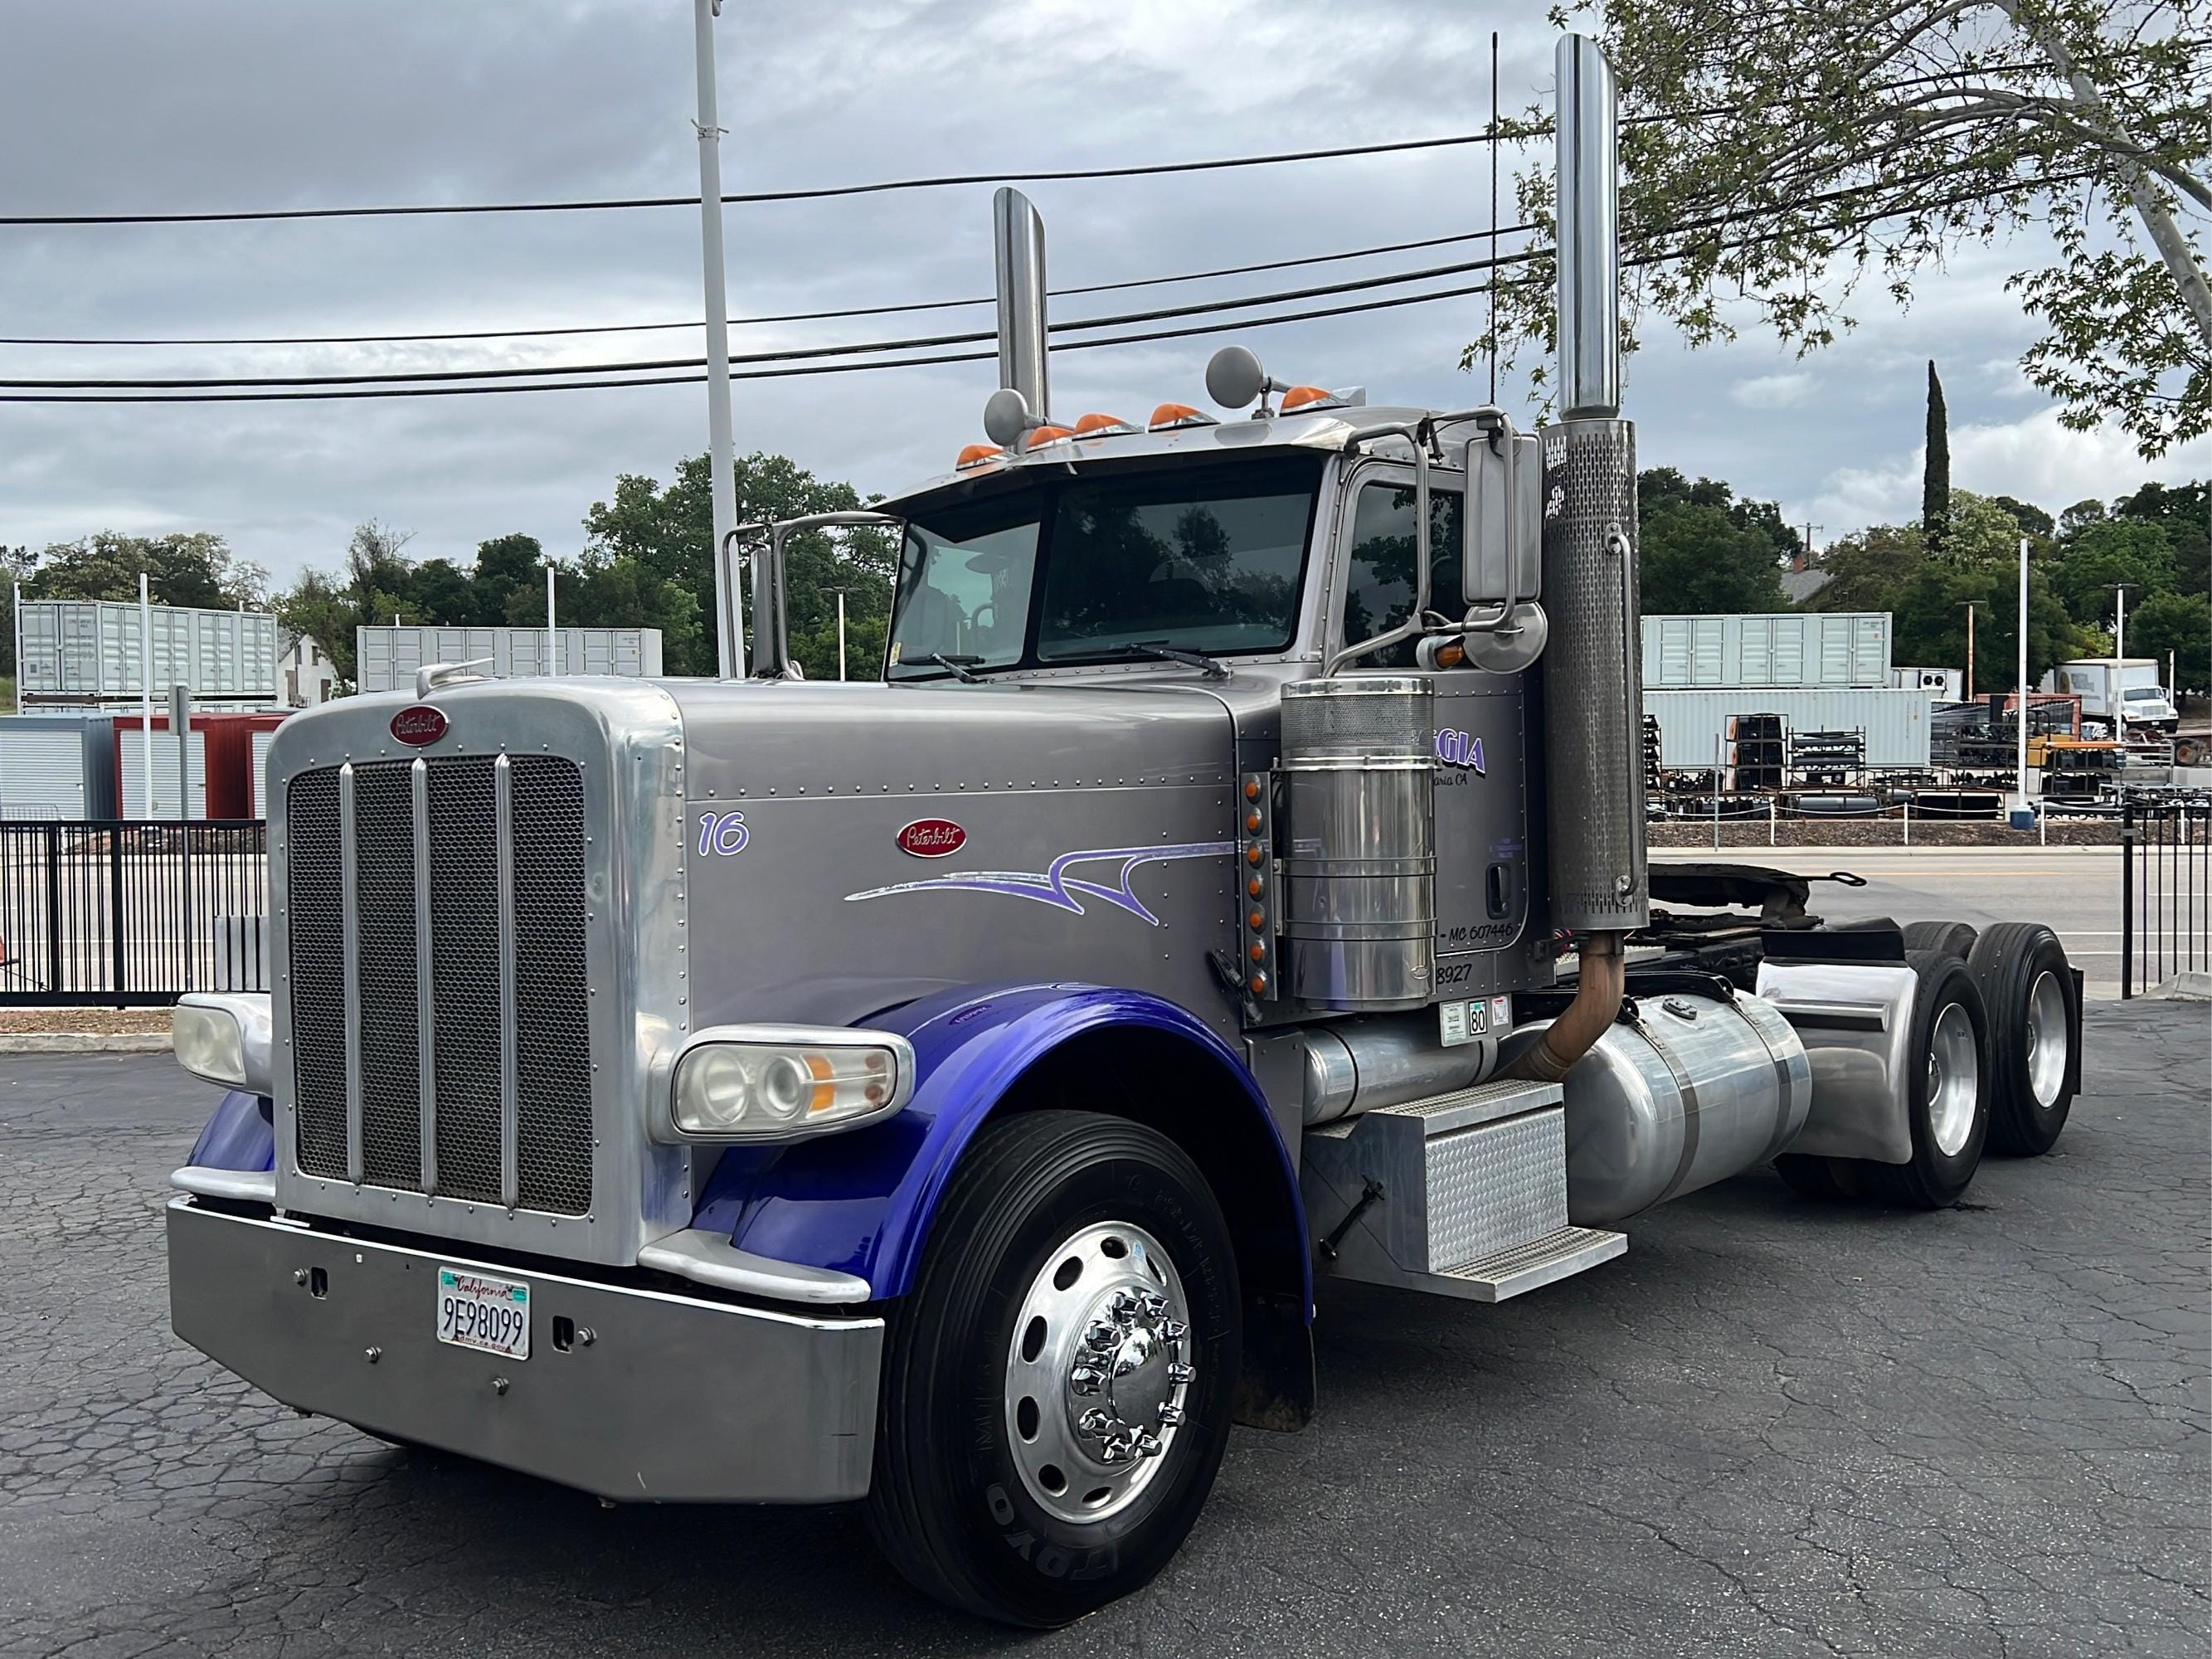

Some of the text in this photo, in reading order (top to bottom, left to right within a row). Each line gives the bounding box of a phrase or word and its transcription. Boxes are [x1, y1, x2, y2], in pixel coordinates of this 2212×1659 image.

[396, 713, 441, 737] Peterbilt
[1432, 727, 1485, 776] GIA
[698, 811, 750, 856] 16
[907, 826, 960, 848] Peterbilt
[1449, 927, 1466, 941] MC
[1470, 922, 1514, 940] 607446
[1471, 1010, 1485, 1032] 80
[457, 1275, 513, 1301] California
[443, 1297, 523, 1345] 9E98099
